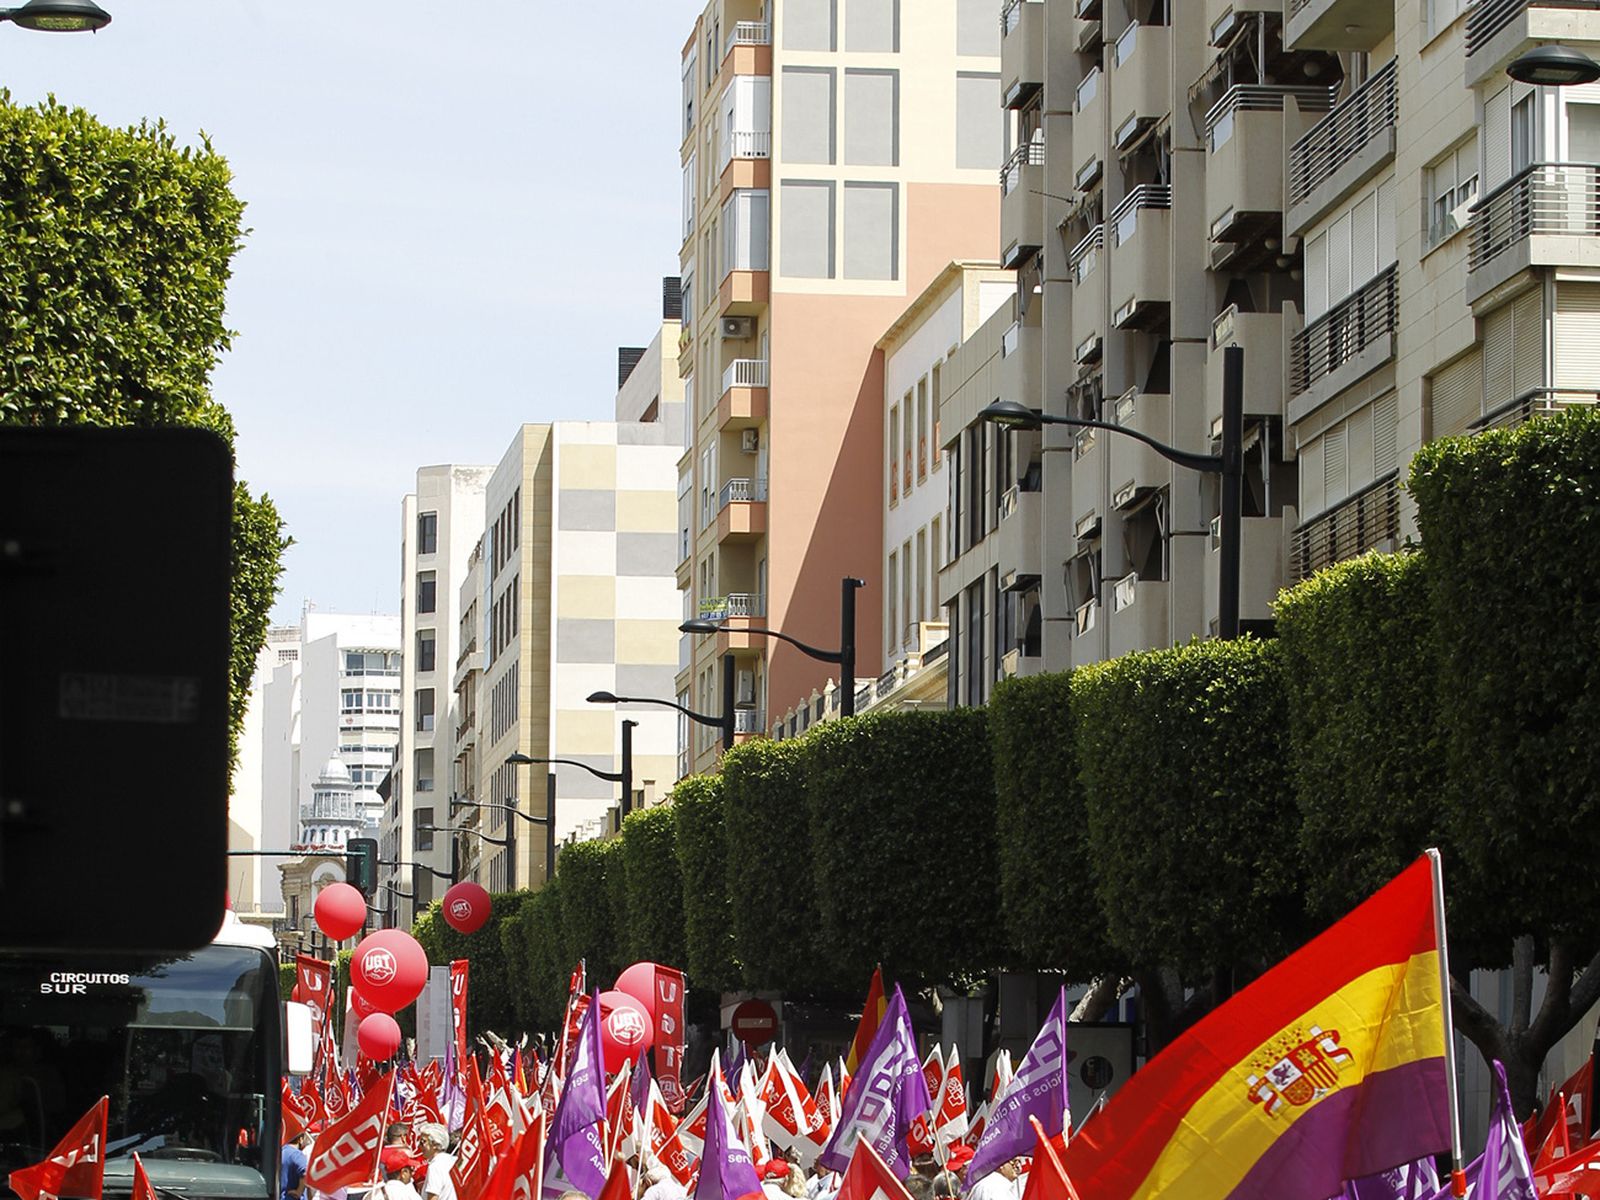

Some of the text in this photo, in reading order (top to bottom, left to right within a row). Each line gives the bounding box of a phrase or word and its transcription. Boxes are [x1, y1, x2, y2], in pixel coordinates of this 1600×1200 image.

[365, 954, 390, 970] UGT
[50, 972, 129, 984] CIRCUITOS
[40, 983, 87, 994] SUR
[613, 1012, 641, 1030] UGT
